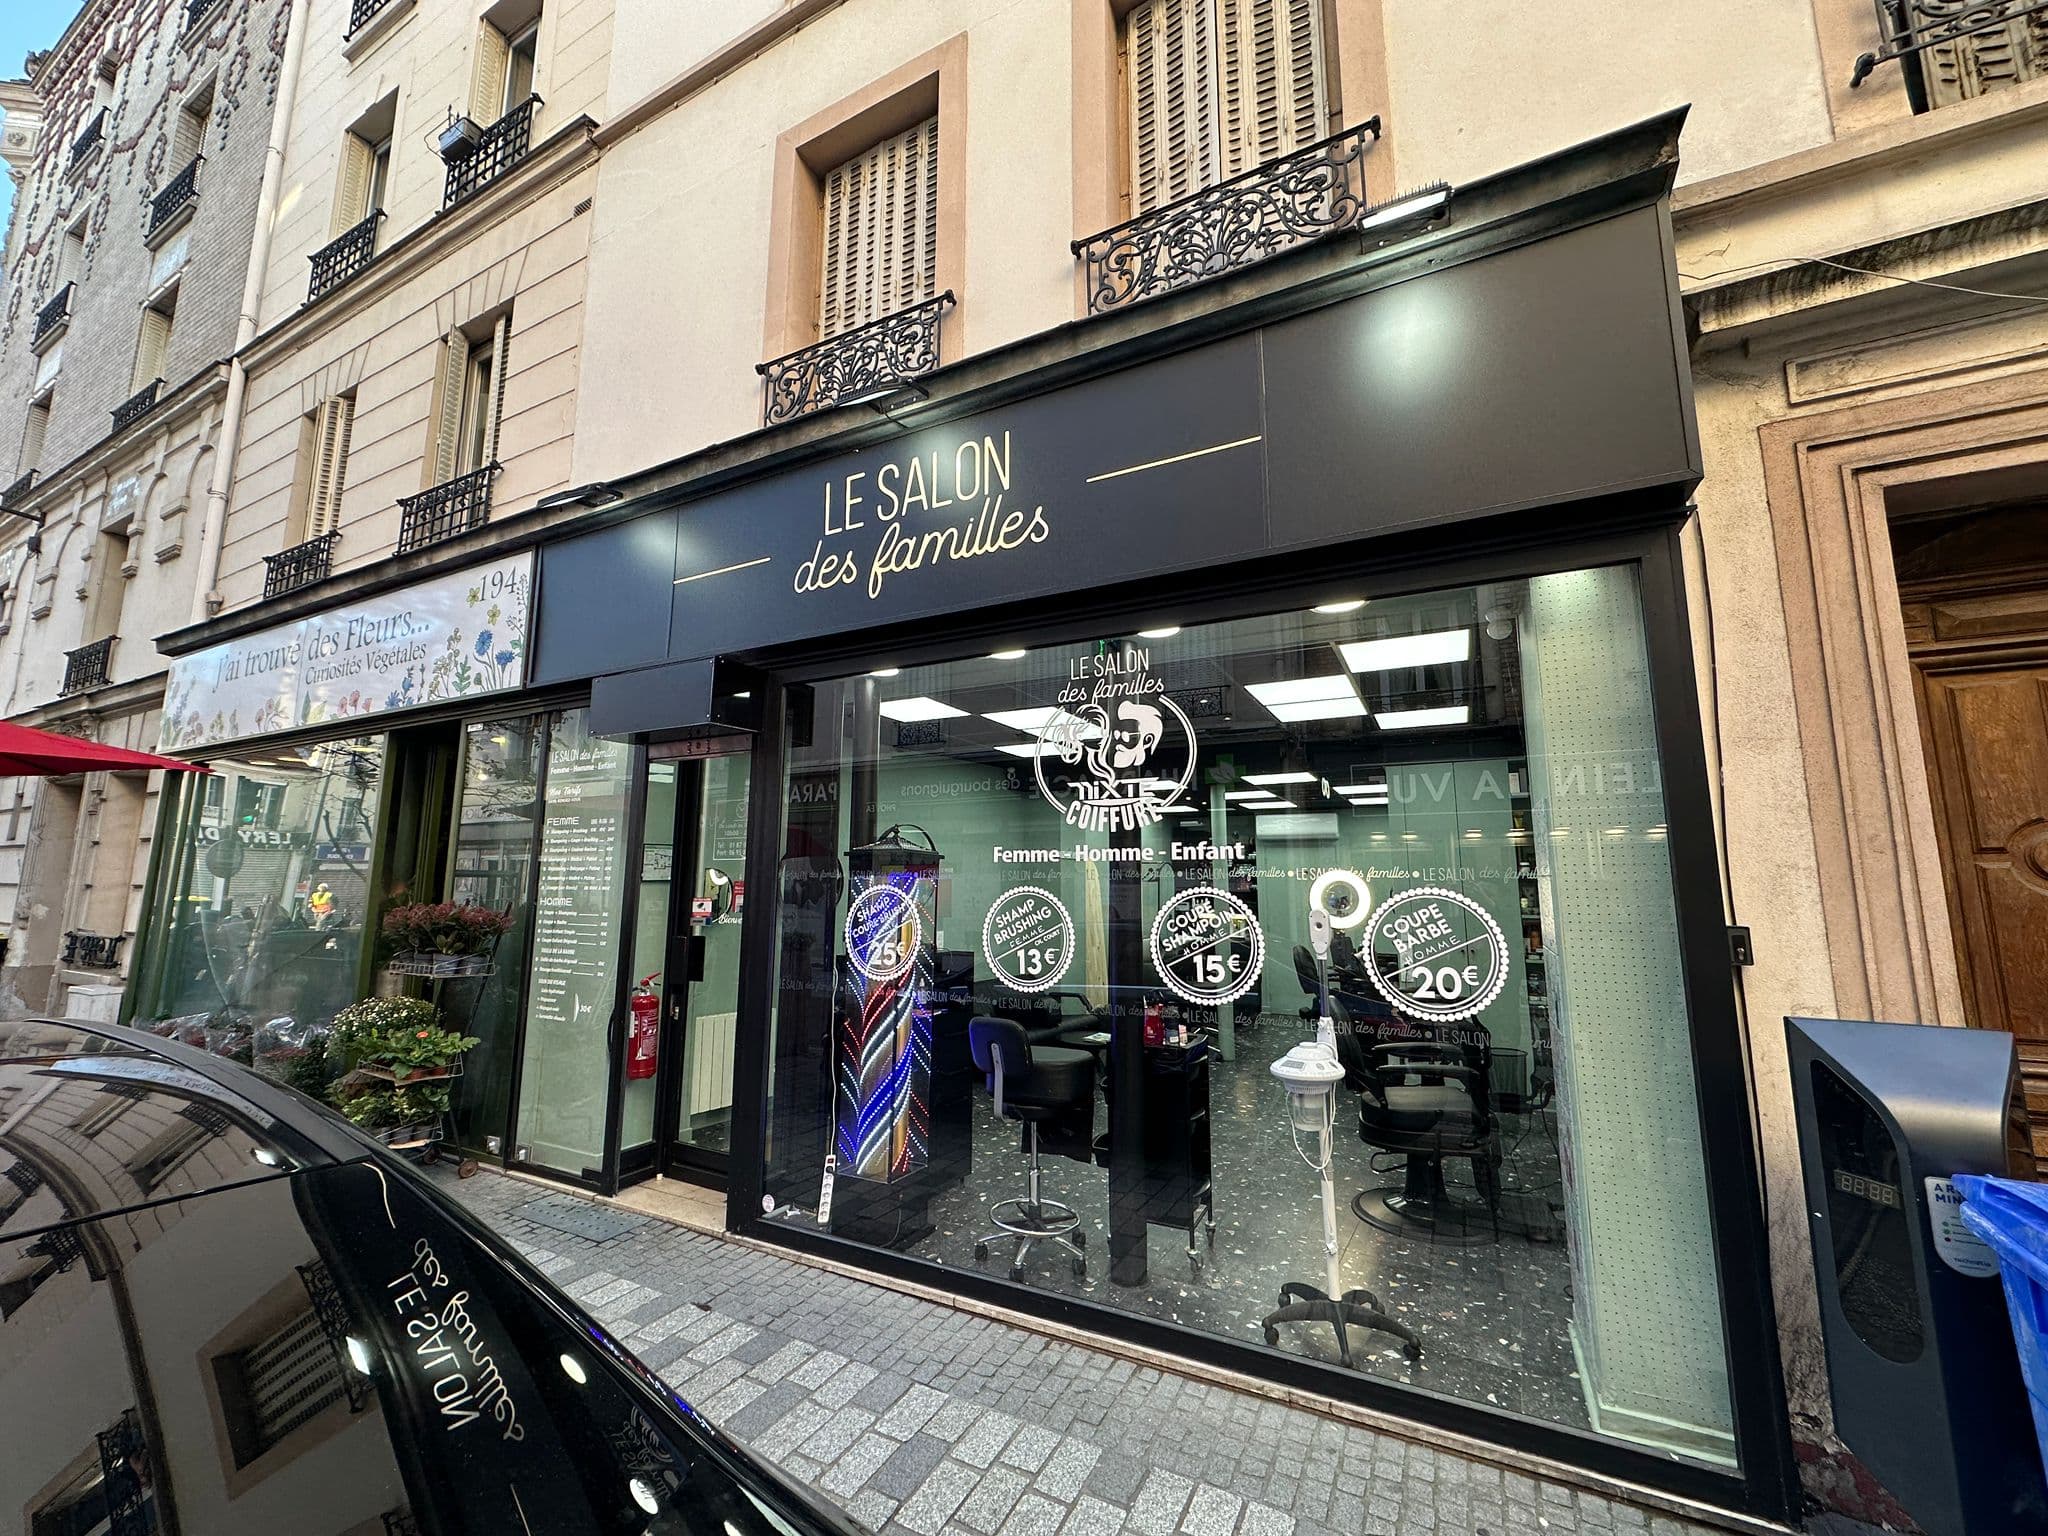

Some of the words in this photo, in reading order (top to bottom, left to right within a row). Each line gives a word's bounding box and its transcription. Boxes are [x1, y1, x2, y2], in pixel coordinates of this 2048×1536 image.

[825, 472, 865, 535] LE
[877, 430, 1010, 522] SALON
[794, 540, 858, 594] des
[868, 494, 1049, 599] familles
[480, 565, 517, 602] 194
[212, 652, 243, 693] J'ai
[246, 636, 302, 678] trouvé
[308, 627, 340, 660] des
[305, 657, 362, 686] Curiosités
[366, 640, 428, 675] Végétales
[1070, 655, 1090, 681] LE
[1094, 647, 1150, 678] SALON
[1057, 682, 1088, 704] des
[1092, 672, 1165, 706] familles
[546, 816, 580, 827] FEMME
[1065, 801, 1165, 832] COIFFURE
[993, 845, 1060, 863] Femme
[1075, 844, 1154, 862] Homme
[1171, 841, 1245, 861] Enfant
[1367, 866, 1410, 883] familles
[1423, 868, 1436, 881] LE
[1438, 867, 1475, 881] SALON
[540, 897, 573, 906] HOMME
[857, 896, 890, 922] SHAMP
[995, 898, 1035, 928] SHAMP
[1166, 898, 1215, 933] COUPE
[993, 906, 1052, 945] BRUSHING
[1382, 903, 1443, 938] COUPE
[1183, 928, 1227, 956] HOMME
[1393, 919, 1453, 954] BARBE
[1404, 935, 1461, 966] HOMME
[869, 941, 906, 967] 25€
[1017, 948, 1061, 975] 13€
[1193, 954, 1241, 984] 15€
[1411, 965, 1480, 1000] 20€
[1355, 1021, 1375, 1034] des
[1377, 1023, 1422, 1041] familles
[1435, 1030, 1449, 1044] LE
[1451, 1030, 1490, 1047] SALON
